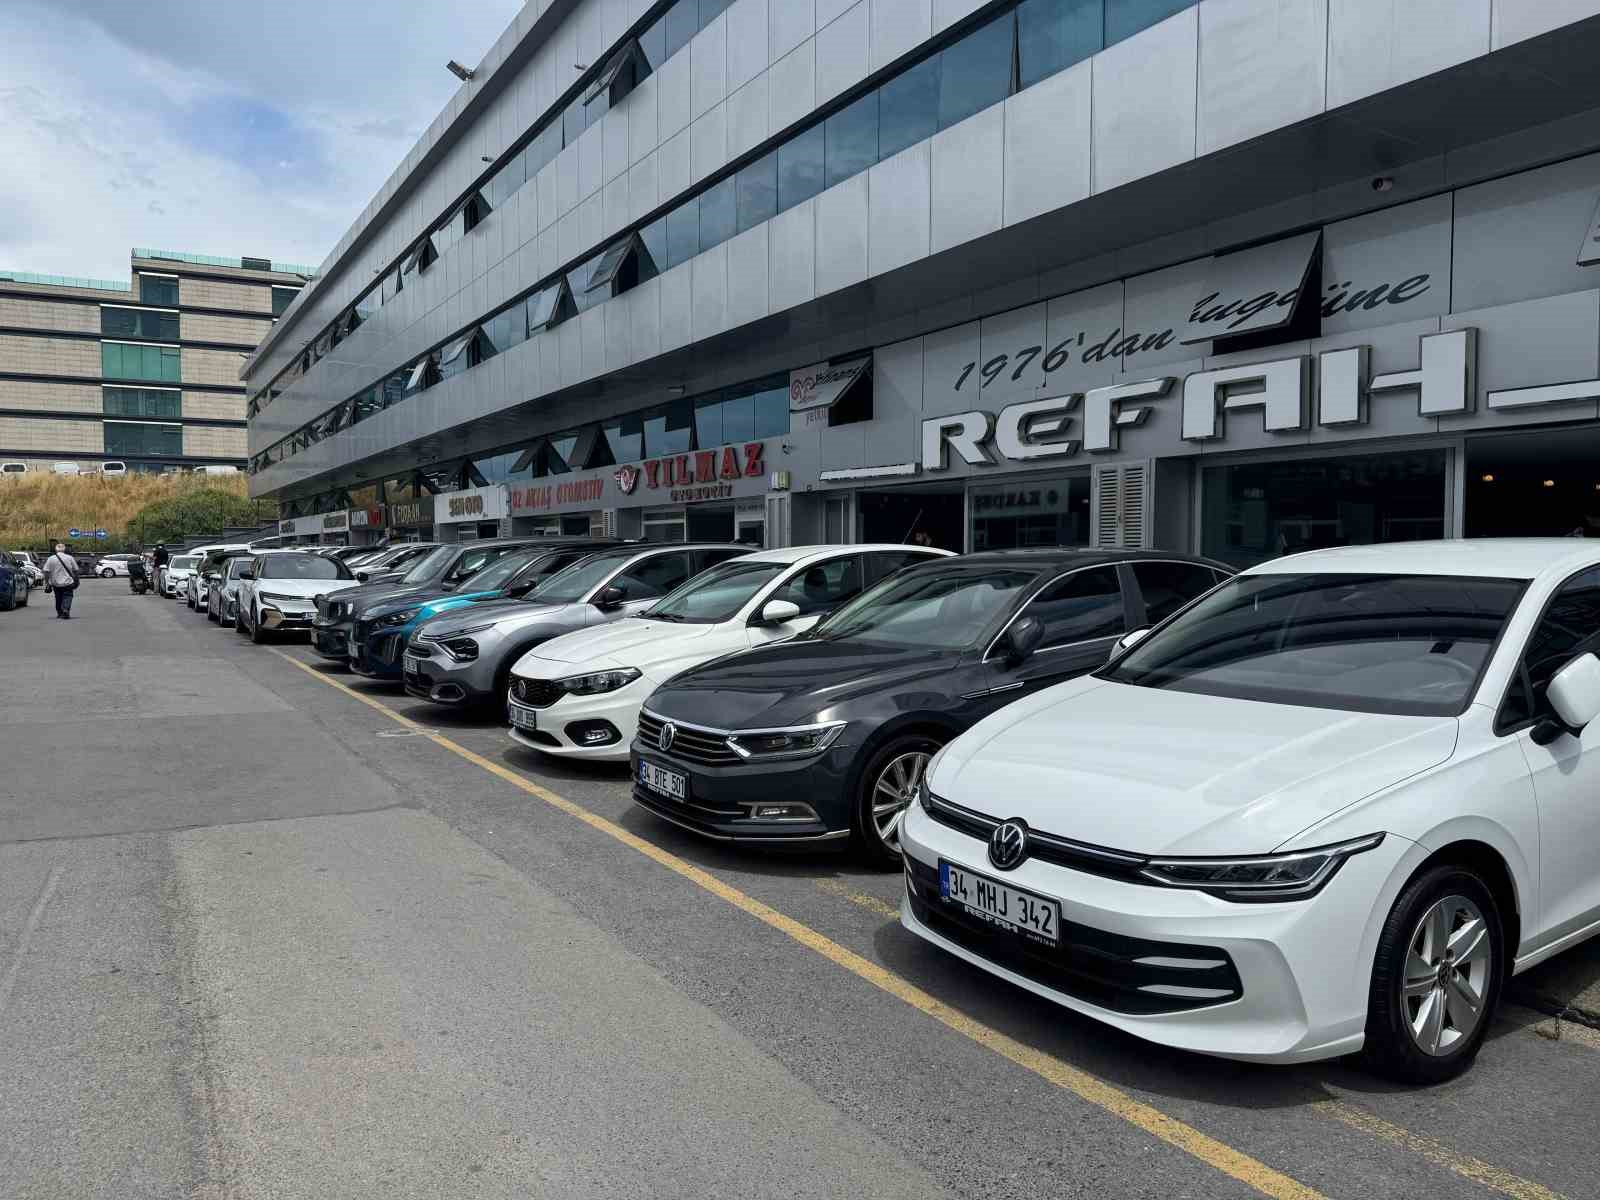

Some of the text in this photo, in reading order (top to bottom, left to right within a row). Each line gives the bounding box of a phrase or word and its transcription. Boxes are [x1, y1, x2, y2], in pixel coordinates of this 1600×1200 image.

[955, 328, 1176, 391] 1976'dan
[921, 327, 1478, 474] REFAH
[643, 442, 764, 489] YILMAZ
[950, 871, 1053, 935] 34 MHJ 342
